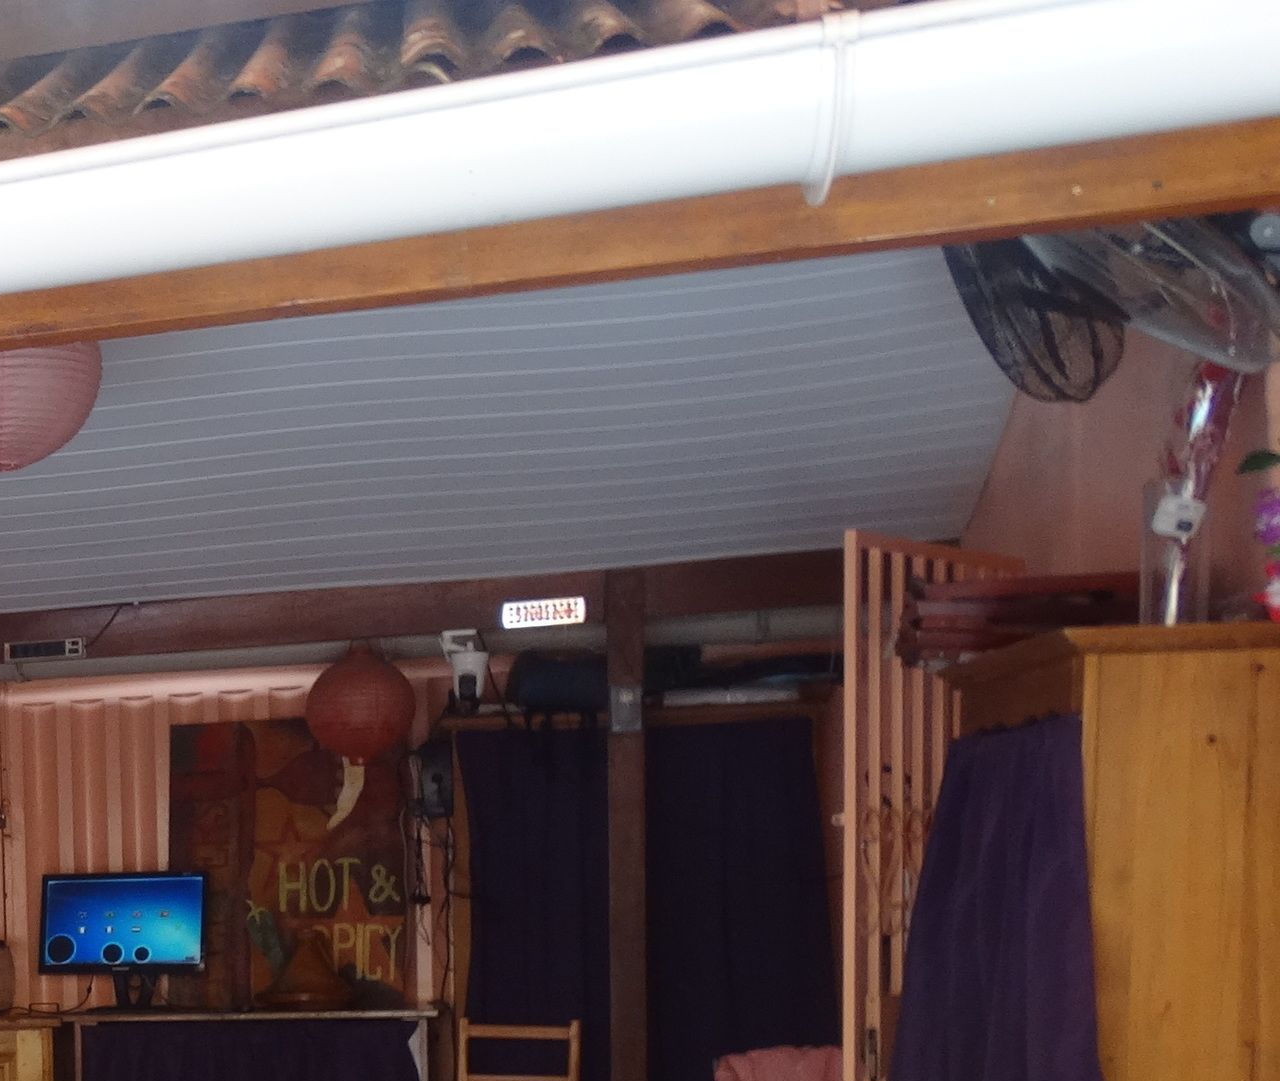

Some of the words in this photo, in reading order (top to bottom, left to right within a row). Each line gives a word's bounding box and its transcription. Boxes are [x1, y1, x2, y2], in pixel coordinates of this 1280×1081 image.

[278, 857, 361, 912] HOT
[368, 864, 401, 903] &
[312, 921, 403, 982] PICY
